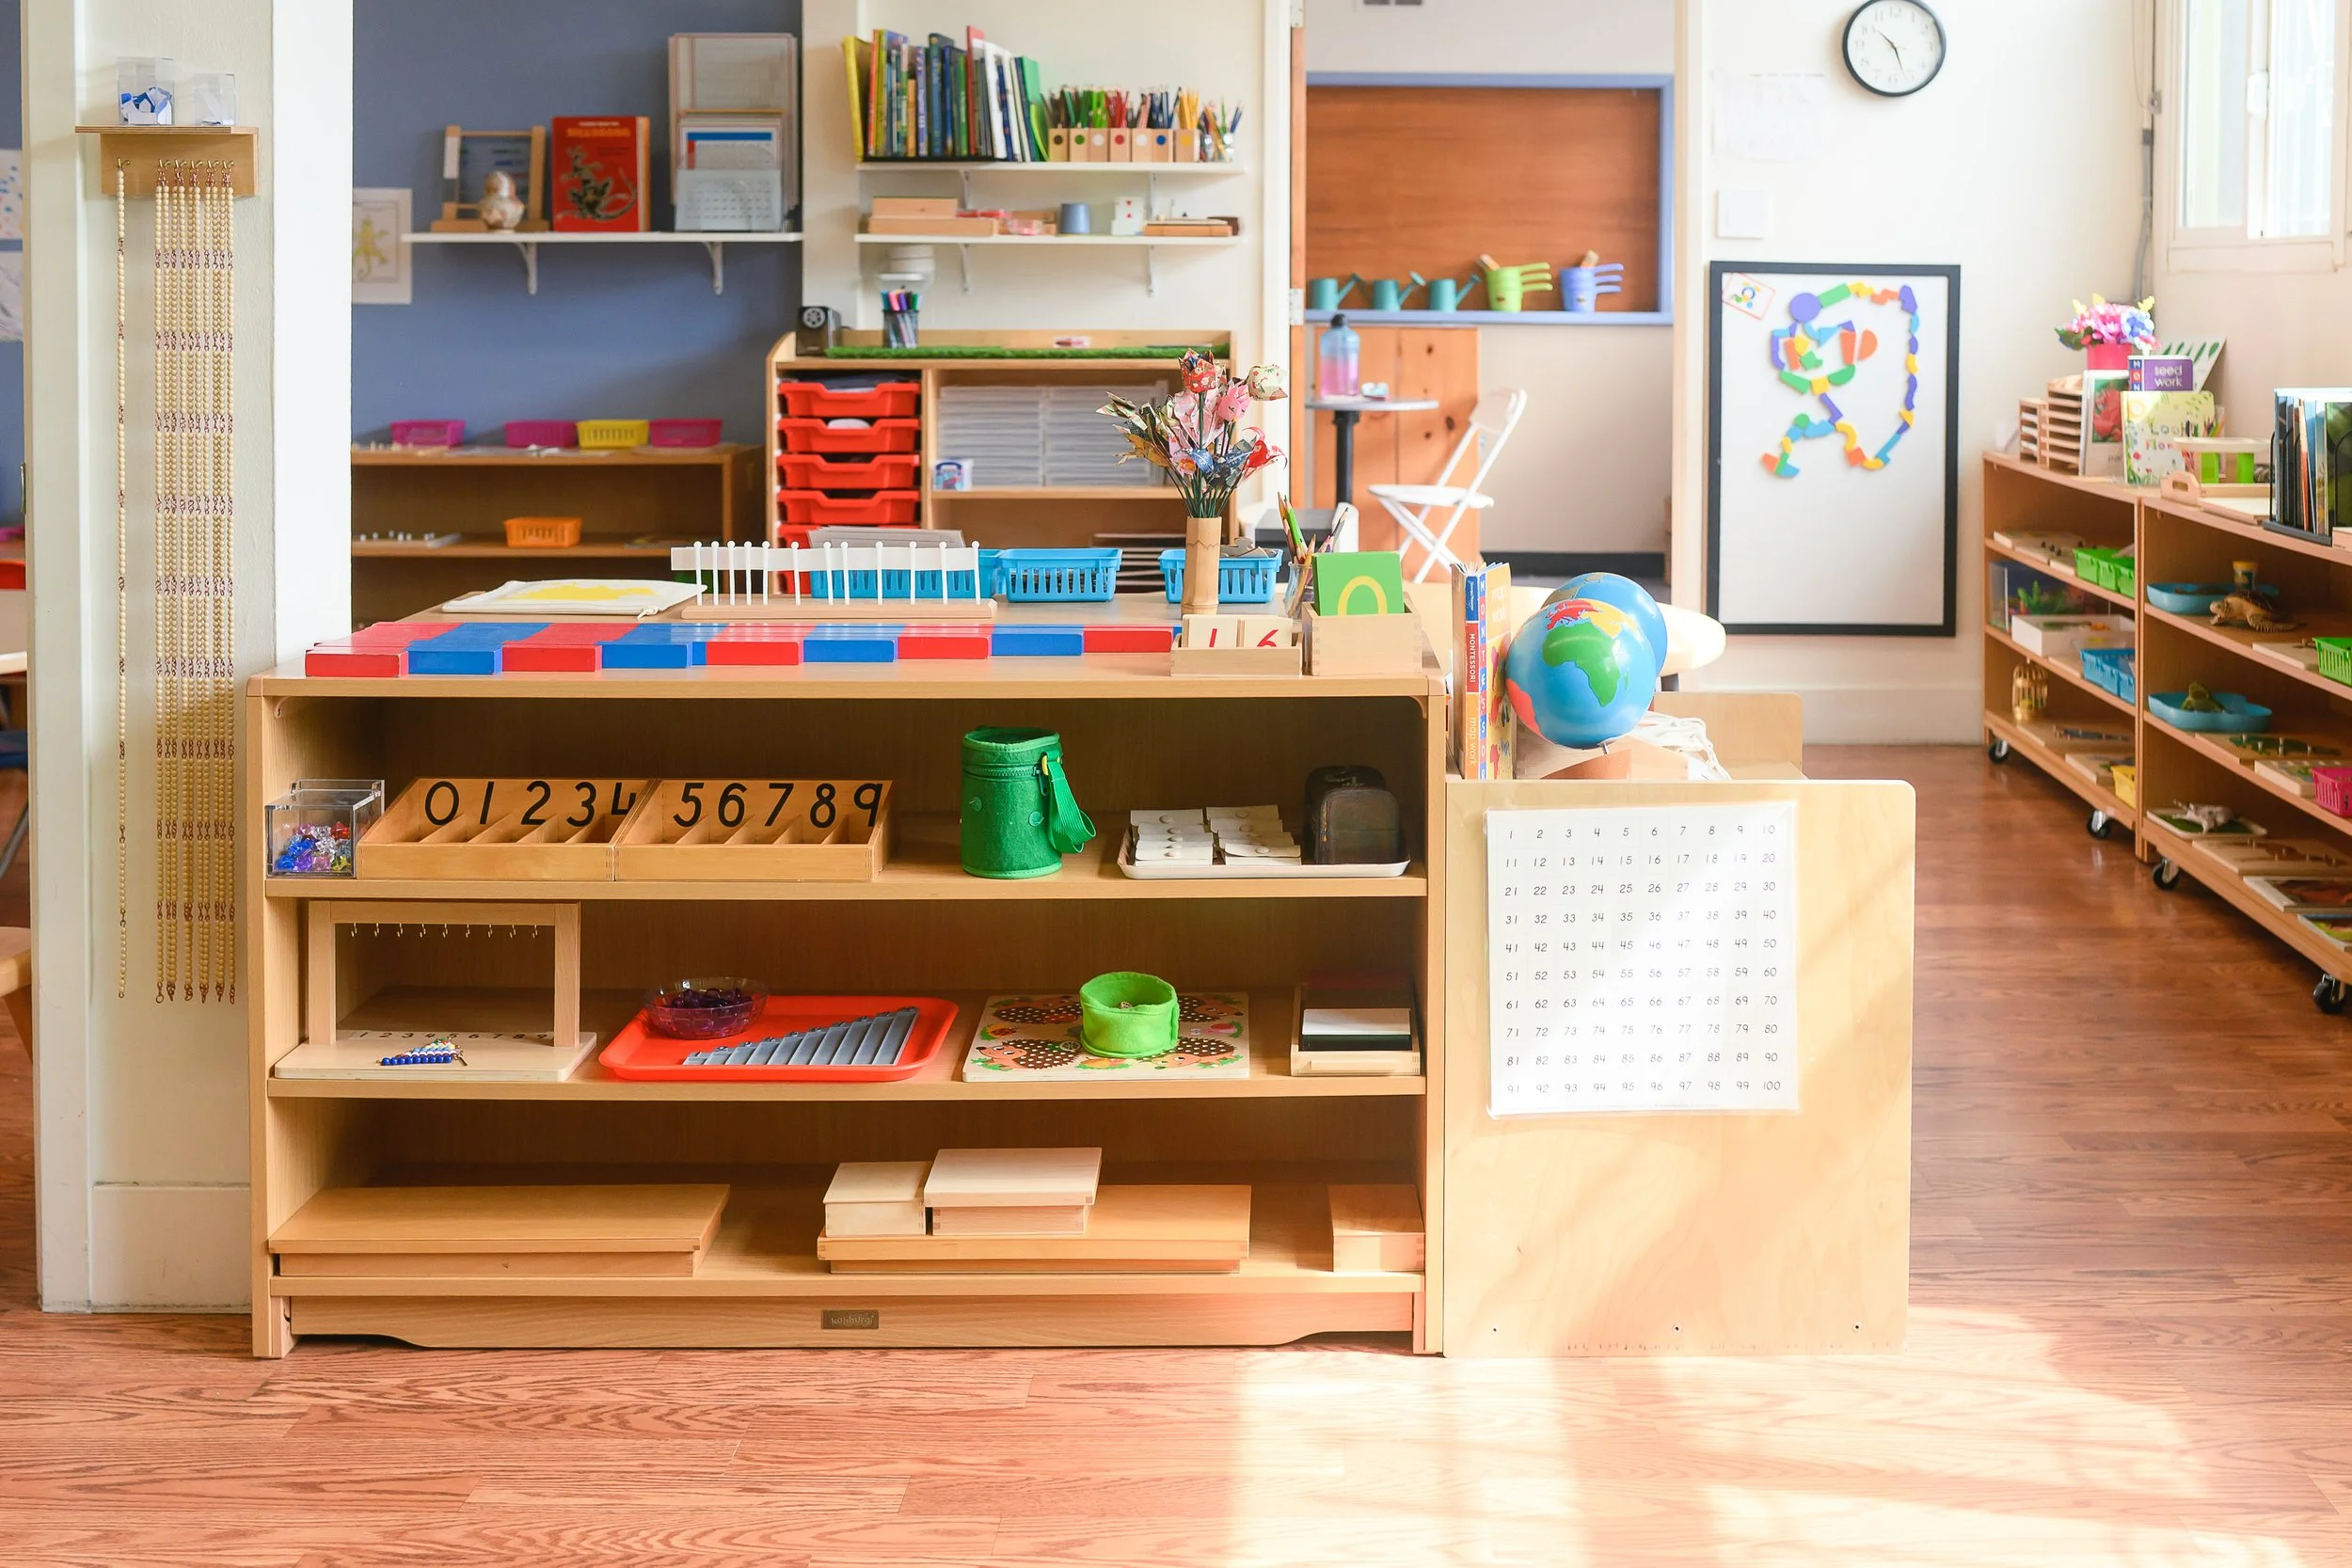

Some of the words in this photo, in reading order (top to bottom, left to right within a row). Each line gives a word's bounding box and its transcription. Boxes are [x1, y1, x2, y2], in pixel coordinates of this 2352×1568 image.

[1874, 9, 1883, 22] 11
[2154, 365, 2183, 376] seed
[2154, 376, 2183, 388] work
[1469, 717, 1477, 739] map
[424, 781, 460, 826] 0
[480, 781, 495, 824] 1
[521, 781, 551, 826] 2
[566, 781, 596, 828] 3
[673, 783, 706, 828] 5
[717, 783, 746, 828] 6
[764, 783, 794, 827] 7
[809, 783, 837, 829] 8
[853, 783, 882, 828] 9
[1509, 830, 1513, 840] 1
[1536, 829, 1544, 839] 2
[1565, 828, 1572, 838] 3
[1594, 828, 1600, 838] 4
[1622, 827, 1629, 837] 5
[1650, 827, 1658, 836] 6
[1679, 825, 1687, 836] 7
[1708, 825, 1715, 835] 8
[1737, 825, 1744, 834] 9
[1505, 858, 1518, 868] 11
[1534, 857, 1547, 867] 12
[1563, 857, 1576, 866] 13
[1591, 856, 1604, 866] 14
[1619, 855, 1633, 865] 15
[1648, 855, 1661, 865] 16
[1677, 853, 1690, 864] 17
[1706, 853, 1719, 864] 18
[1761, 852, 1776, 863] 20
[1504, 886, 1518, 896] 21
[1533, 885, 1548, 895] 22
[1562, 884, 1576, 895] 23
[1590, 884, 1604, 895] 24
[1619, 883, 1633, 894] 25
[1647, 882, 1661, 894] 26
[1677, 882, 1690, 893] 27
[1733, 881, 1747, 892] 29
[1762, 881, 1776, 892] 30
[1505, 914, 1518, 925] 31
[1534, 914, 1548, 925] 32
[1563, 913, 1576, 924] 33
[1591, 912, 1604, 923] 34
[1619, 911, 1633, 922] 35
[1648, 911, 1662, 922] 36
[1734, 910, 1748, 920] 39
[1762, 910, 1777, 920] 40
[1505, 943, 1518, 954] 41
[1534, 942, 1548, 953] 42
[1563, 942, 1577, 952] 43
[1591, 941, 1605, 951] 44
[1619, 940, 1633, 951] 45
[1706, 939, 1720, 949] 48
[1734, 938, 1748, 948] 49
[1763, 938, 1777, 949] 50
[1505, 971, 1518, 982] 51
[1534, 971, 1549, 981] 52
[1563, 970, 1577, 980] 53
[1591, 969, 1605, 979] 54
[1706, 967, 1720, 977] 58
[1734, 966, 1748, 977] 59
[1763, 967, 1777, 977] 60
[1505, 1000, 1518, 1010] 61
[1534, 999, 1549, 1009] 62
[1563, 998, 1577, 1008] 63
[1592, 997, 1605, 1007] 64
[1620, 997, 1634, 1007] 65
[1648, 996, 1662, 1006] 66
[1677, 995, 1692, 1006] 67
[1707, 995, 1720, 1006] 68
[1735, 995, 1749, 1006] 69
[1764, 995, 1778, 1006] 70
[1506, 1027, 1519, 1038] 71
[1535, 1026, 1549, 1037] 72
[1708, 1023, 1721, 1034] 78
[1736, 1023, 1749, 1034] 79
[1764, 1023, 1778, 1034] 80
[1506, 1055, 1519, 1067] 81
[1649, 1053, 1663, 1063] 86
[1678, 1052, 1692, 1063] 87
[1707, 1052, 1721, 1062] 88
[1736, 1052, 1749, 1062] 89
[1764, 1052, 1778, 1063] 90
[1565, 1083, 1578, 1093] 93
[1593, 1083, 1606, 1092] 94
[1621, 1082, 1635, 1092] 95
[1650, 1081, 1663, 1091] 96
[1678, 1081, 1692, 1091] 97
[1707, 1080, 1721, 1091] 98
[1736, 1080, 1750, 1090] 99
[1763, 1081, 1781, 1091] 100
